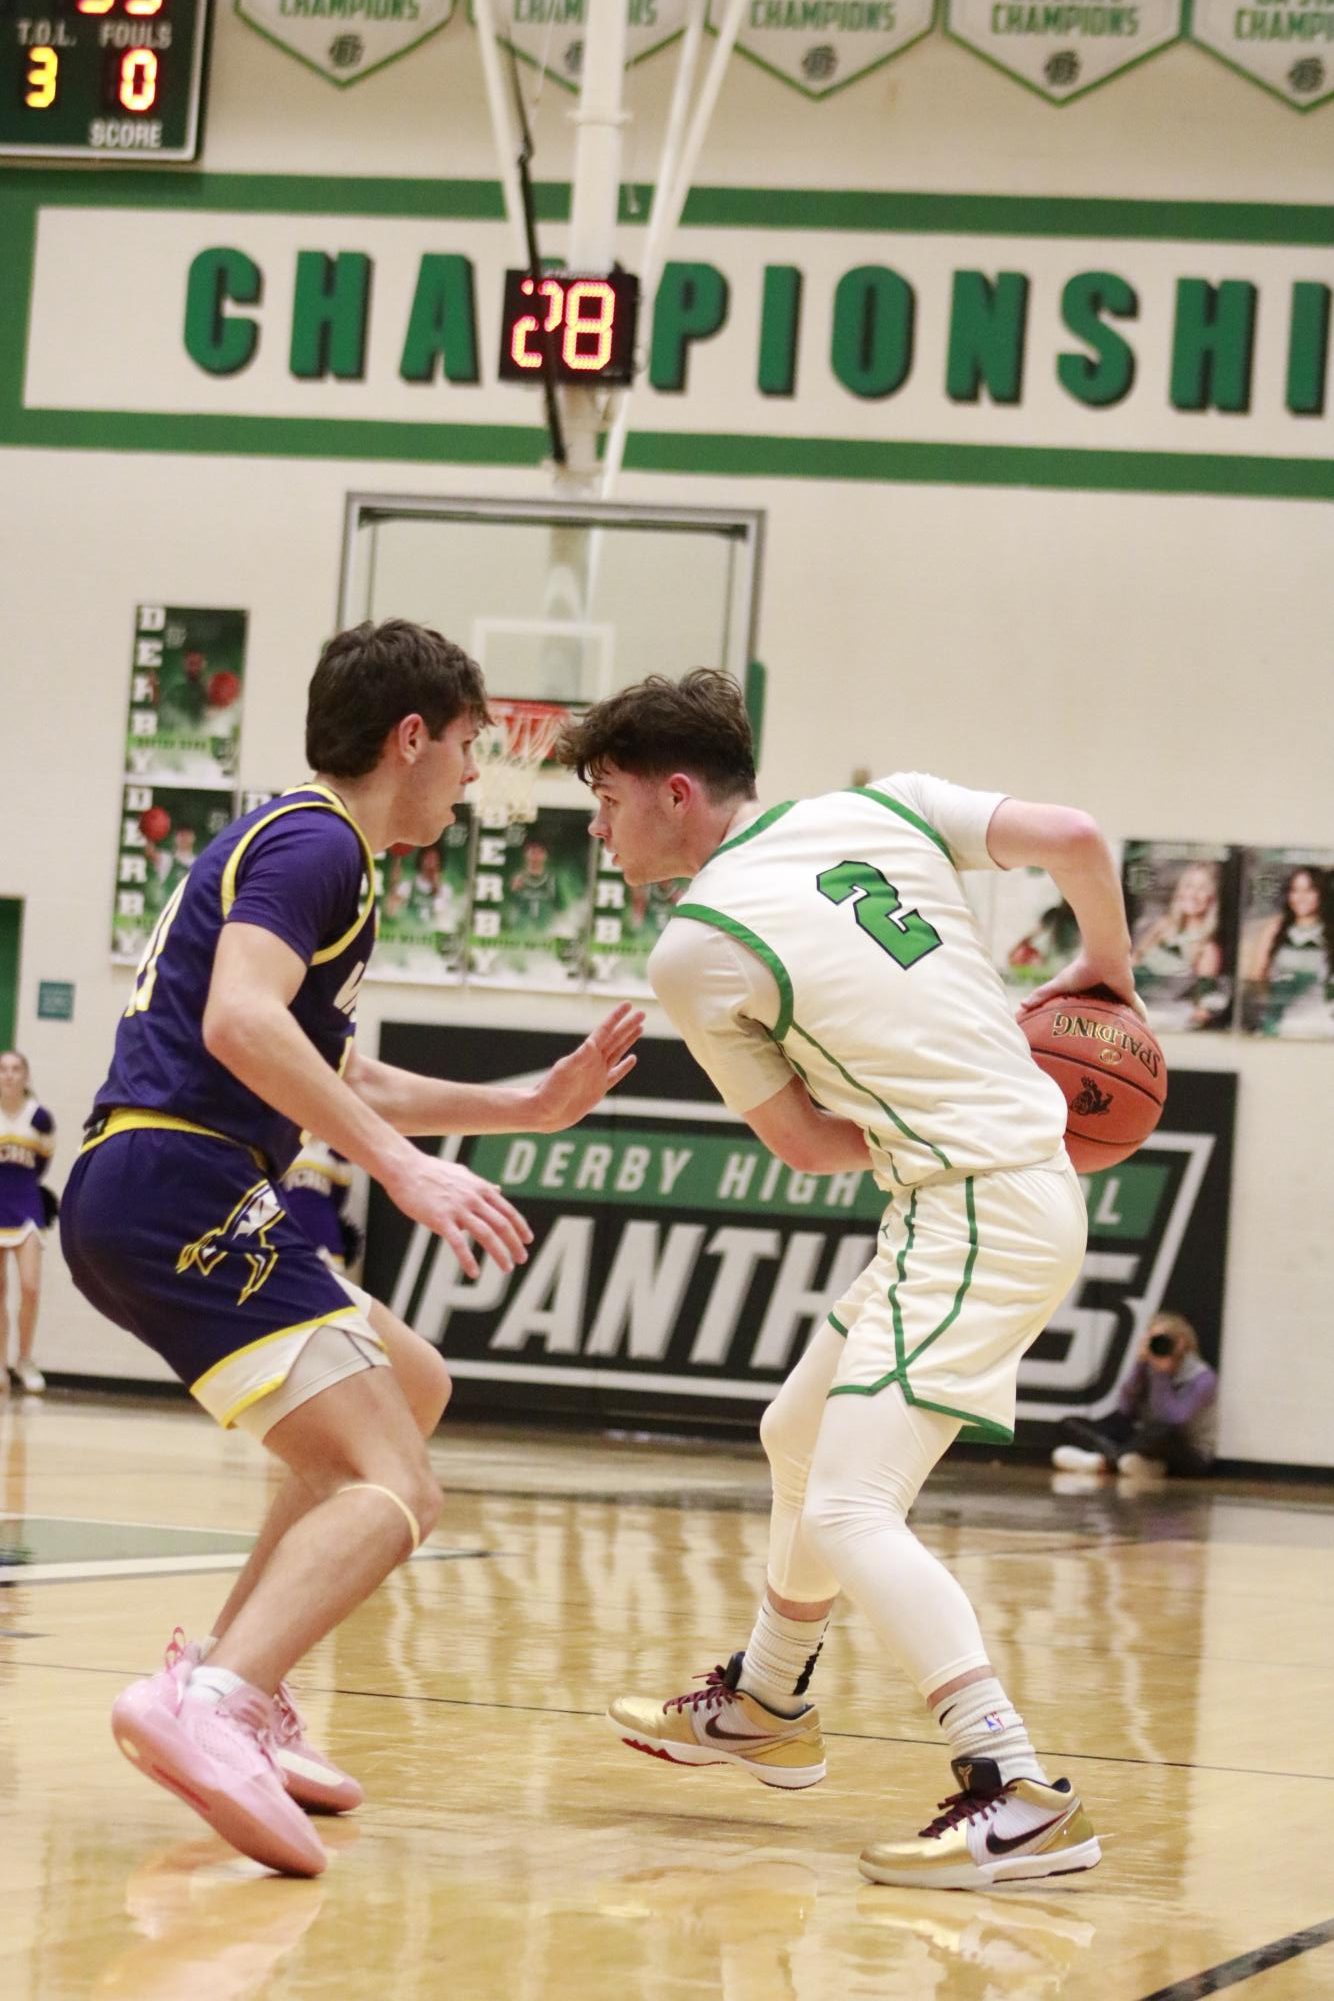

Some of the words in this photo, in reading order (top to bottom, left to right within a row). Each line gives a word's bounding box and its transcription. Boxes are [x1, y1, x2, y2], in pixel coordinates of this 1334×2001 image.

[17, 19, 77, 46] T.O.L.
[99, 20, 172, 49] FOULS
[991, 5, 1138, 36] CHAMPIONS
[26, 46, 59, 108] 3
[119, 48, 158, 111] 0
[88, 118, 163, 148] SCORE
[184, 246, 1332, 417] CHAPIONSHI
[511, 276, 616, 370] 28
[816, 860, 944, 971] 2
[1052, 1011, 1161, 1079] SPALDING
[502, 1138, 693, 1196] DERBY
[716, 1151, 863, 1208] HIGH
[408, 1215, 1140, 1390] PANTHS
